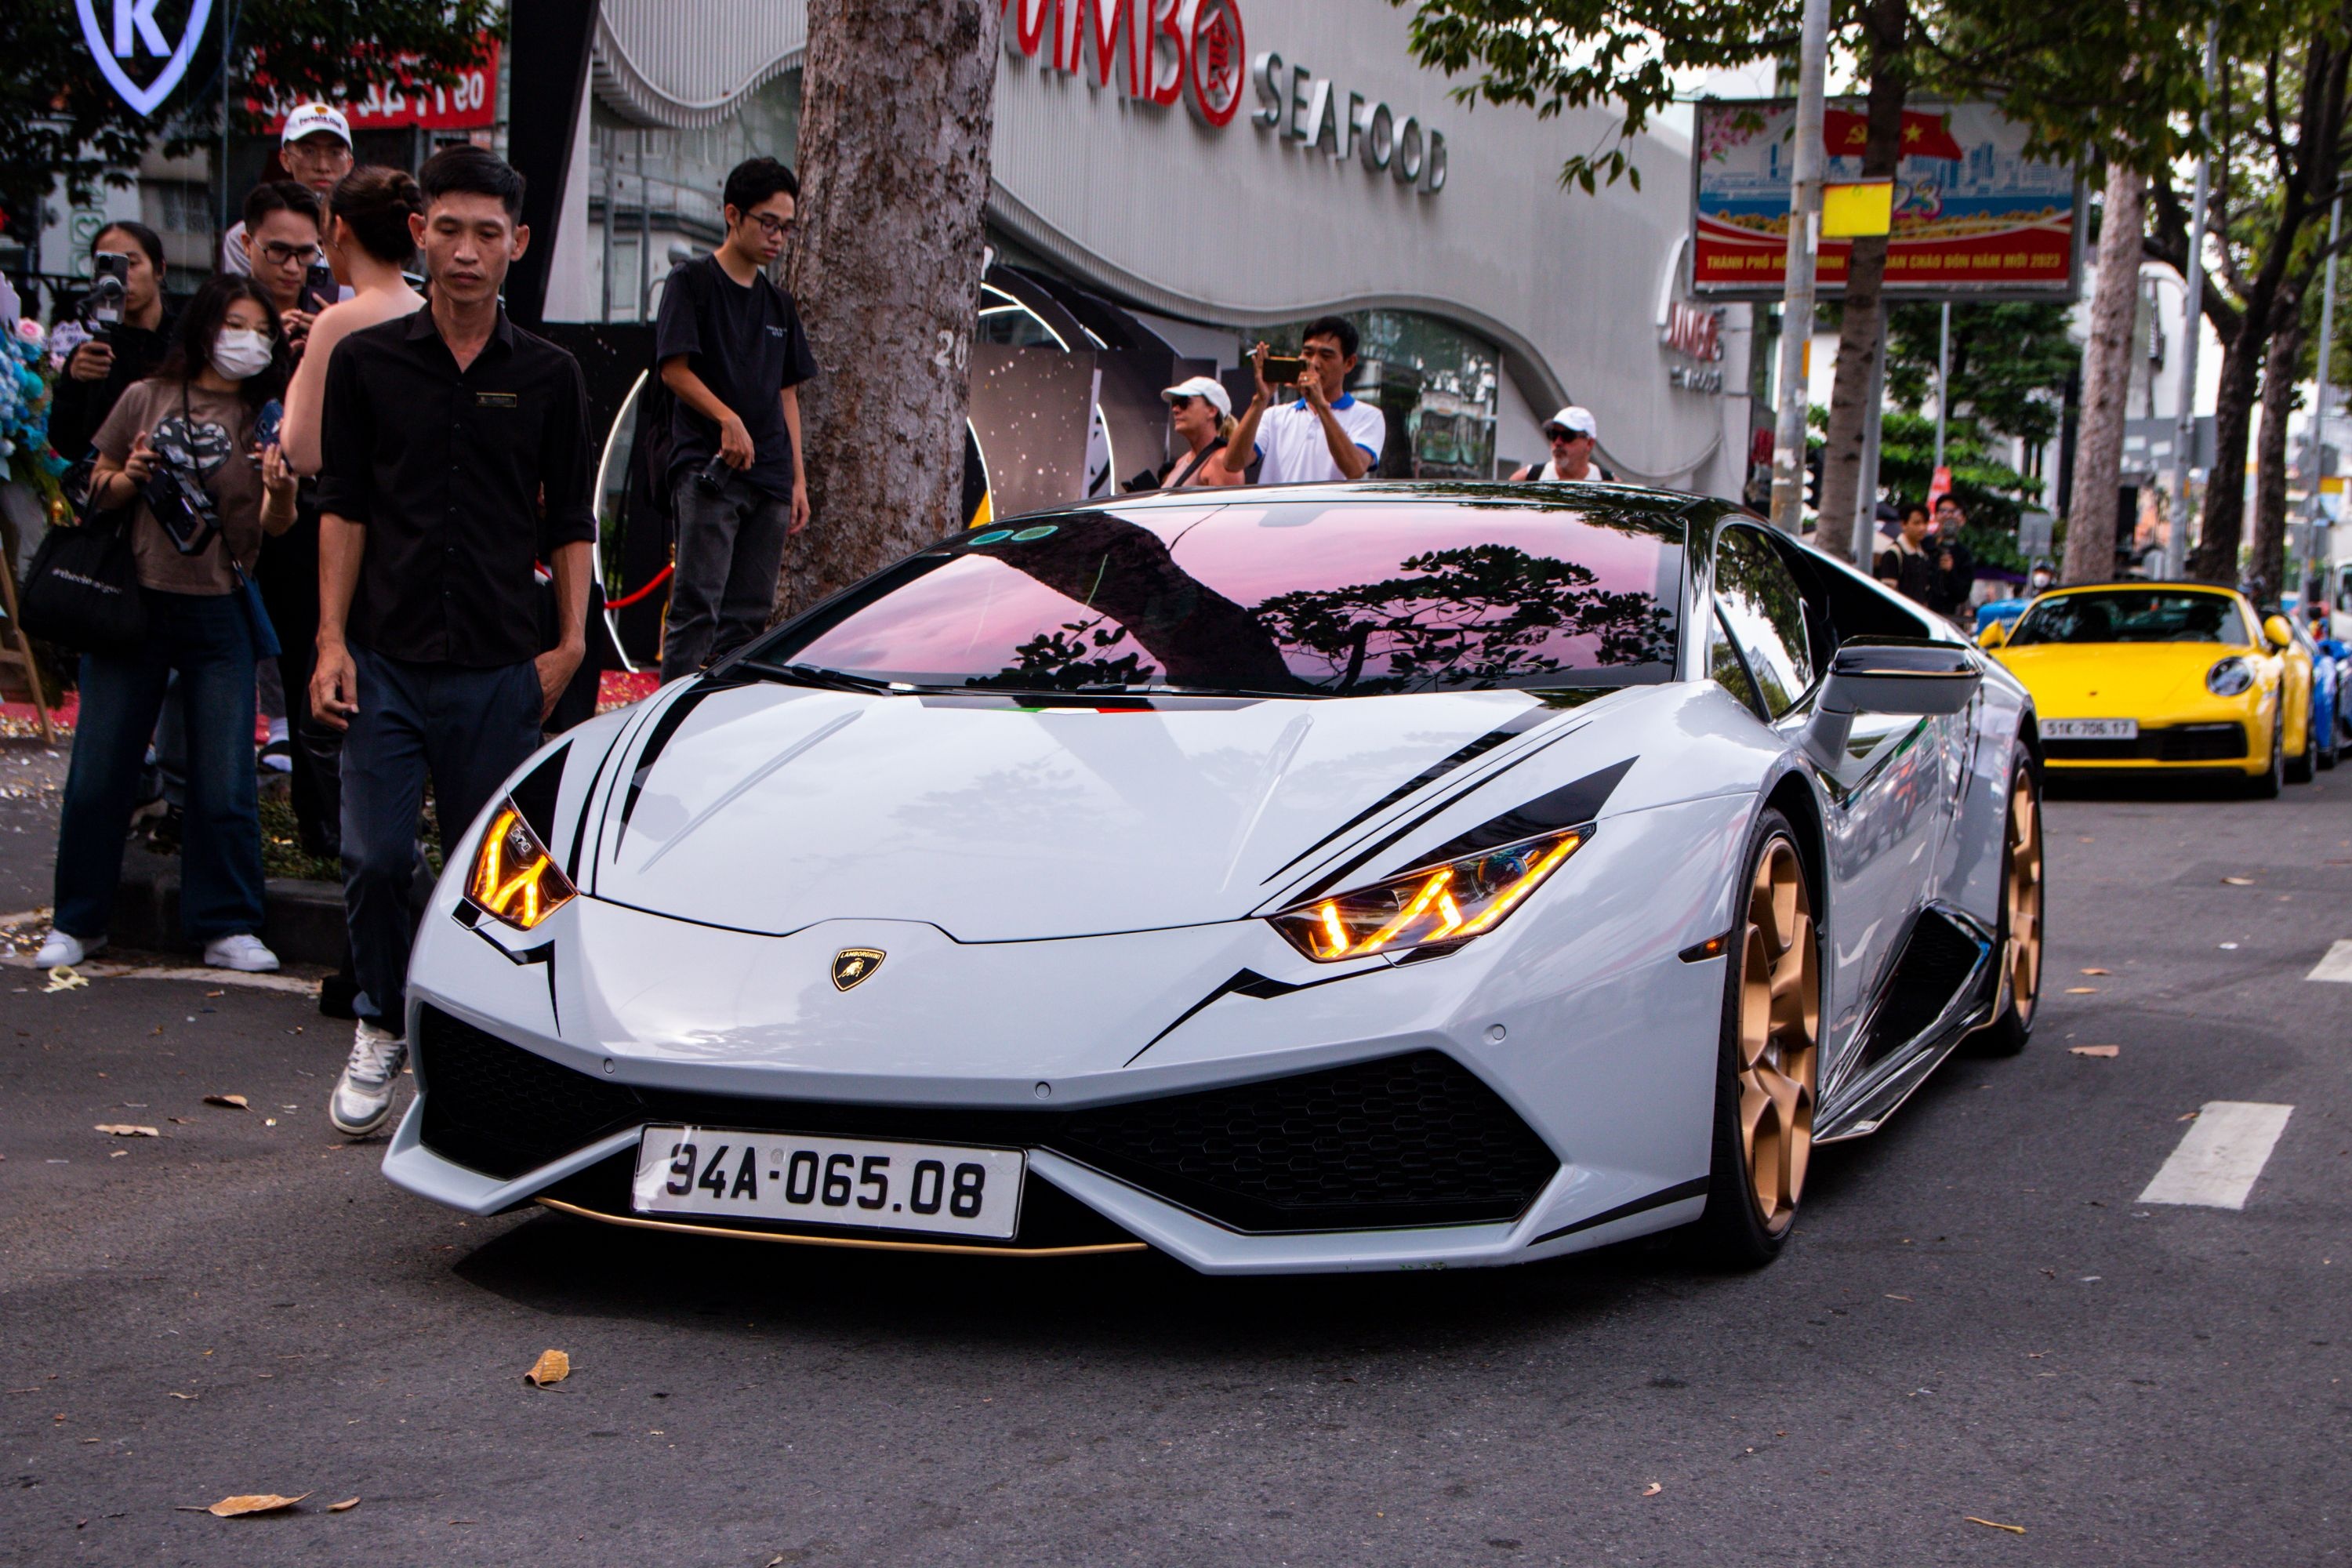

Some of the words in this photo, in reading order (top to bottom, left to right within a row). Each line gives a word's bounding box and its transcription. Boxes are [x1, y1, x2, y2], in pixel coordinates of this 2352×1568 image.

[113, 0, 172, 57] K
[1252, 52, 1447, 193] SEAFOOD
[2030, 252, 2060, 268] 2023
[840, 951, 881, 960] LAMBORGHINI
[666, 1143, 986, 1219] 94A-065.08
